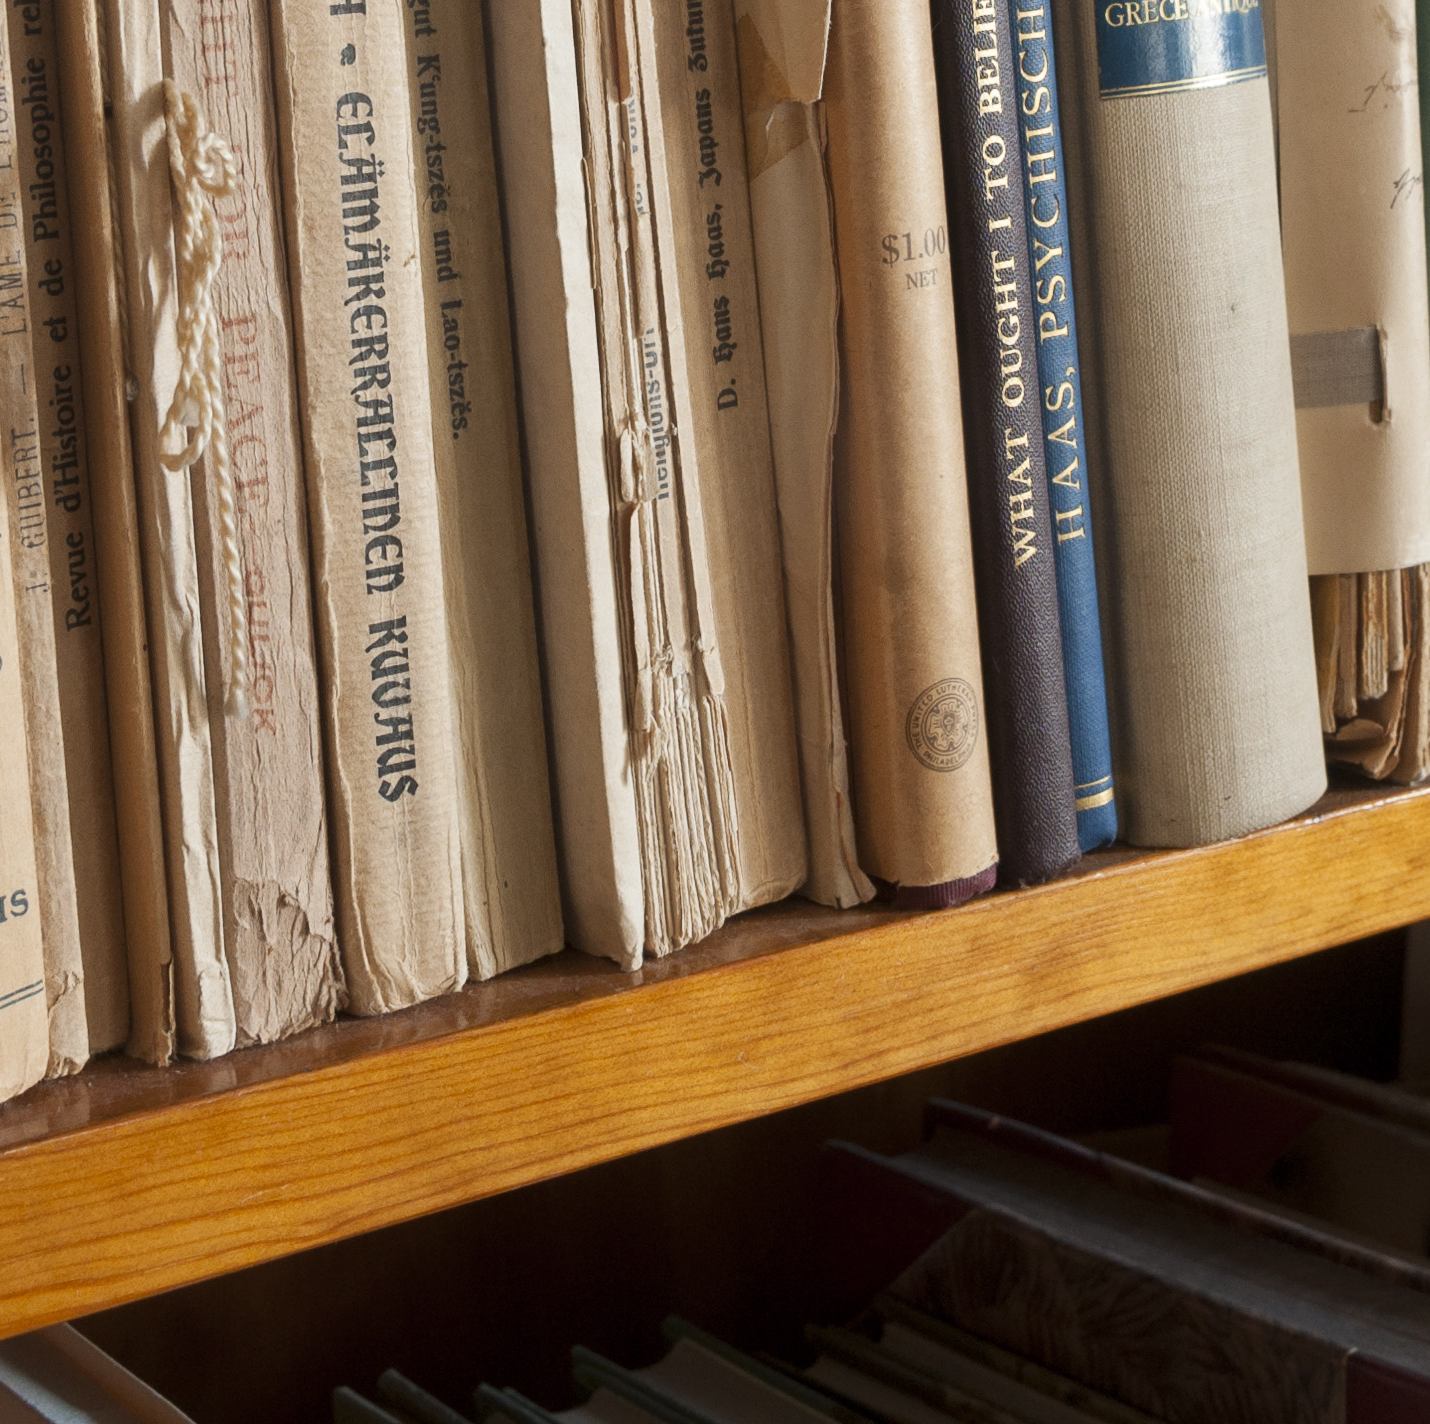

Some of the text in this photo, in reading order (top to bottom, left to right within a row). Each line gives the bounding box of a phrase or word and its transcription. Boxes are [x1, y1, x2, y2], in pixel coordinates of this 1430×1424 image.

[22, 57, 60, 243] Philosophie
[699, 89, 722, 188] Japans
[982, 134, 1009, 192] TO
[435, 228, 455, 281] und
[881, 224, 948, 268] $1.00
[989, 213, 1012, 233] I
[38, 258, 64, 298] de
[906, 267, 939, 291] NET
[43, 316, 67, 342] et
[336, 92, 404, 598] ELÄMÄKERRALLINEN
[712, 294, 737, 366] Hans
[993, 251, 1027, 405] OUGHT
[48, 364, 83, 514] d'Histoire
[217, 313, 269, 507] PEACE
[717, 377, 740, 412] D.
[999, 427, 1037, 570] WHAT
[1044, 365, 1086, 544] HAAS,
[64, 531, 92, 632] Revue
[367, 615, 420, 805] KUVAUS
